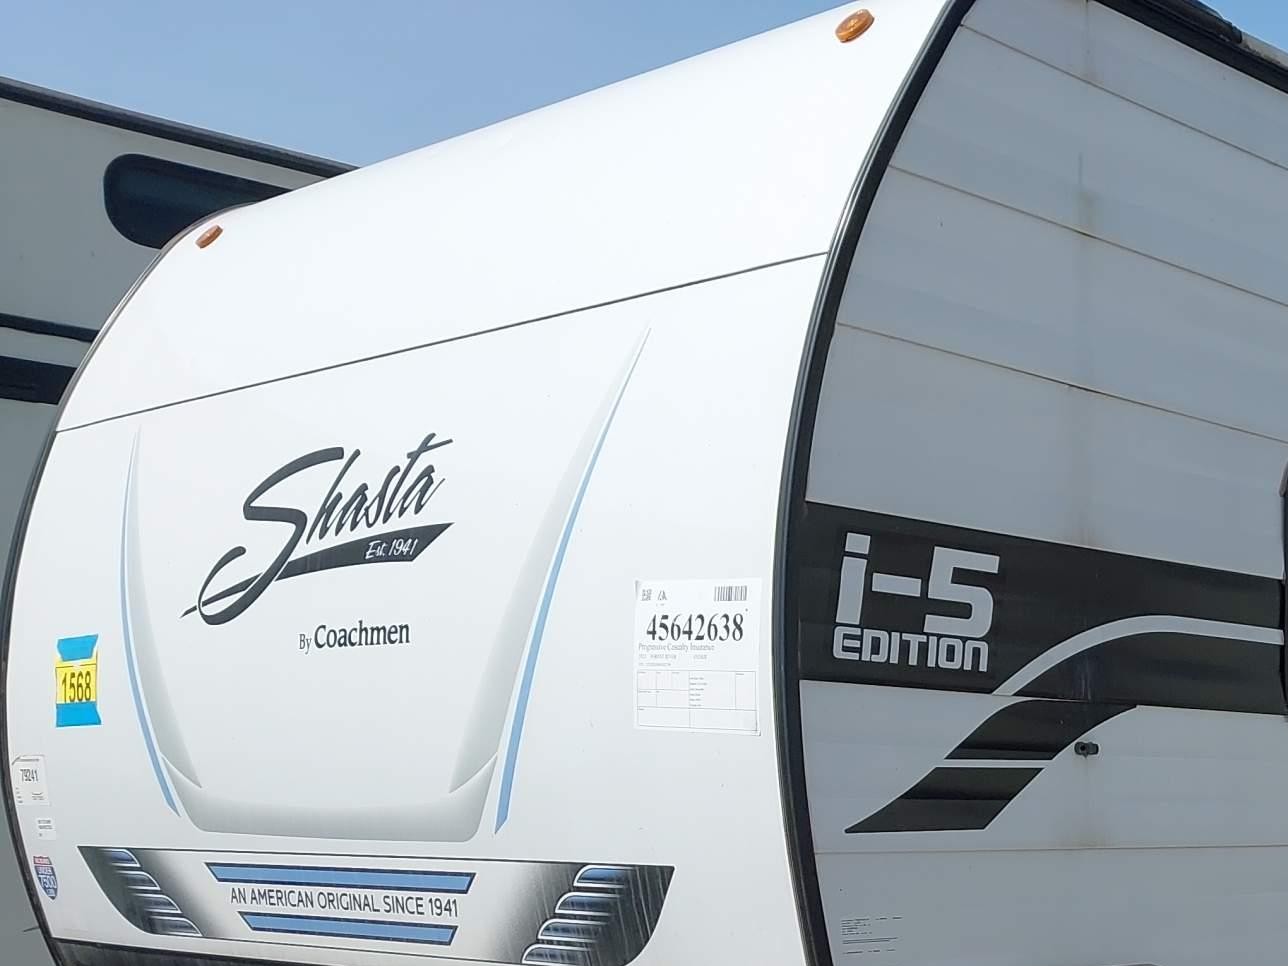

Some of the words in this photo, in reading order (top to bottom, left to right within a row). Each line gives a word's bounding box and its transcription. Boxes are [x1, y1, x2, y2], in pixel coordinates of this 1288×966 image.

[197, 432, 453, 626] Shasta
[364, 540, 386, 559] Est.
[388, 538, 418, 556] 1941
[835, 532, 1000, 638] i-5
[299, 633, 312, 654] By
[314, 620, 410, 648] Coachmen
[646, 613, 744, 641] 45642638
[833, 626, 989, 672] EDITION
[61, 671, 92, 703] 1568
[19, 768, 39, 782] 79241
[230, 887, 247, 904] AN
[250, 889, 314, 909] AMERICAN
[317, 891, 381, 913] ORIGINAL
[383, 895, 425, 916] SINCE
[428, 897, 459, 918] 1941
